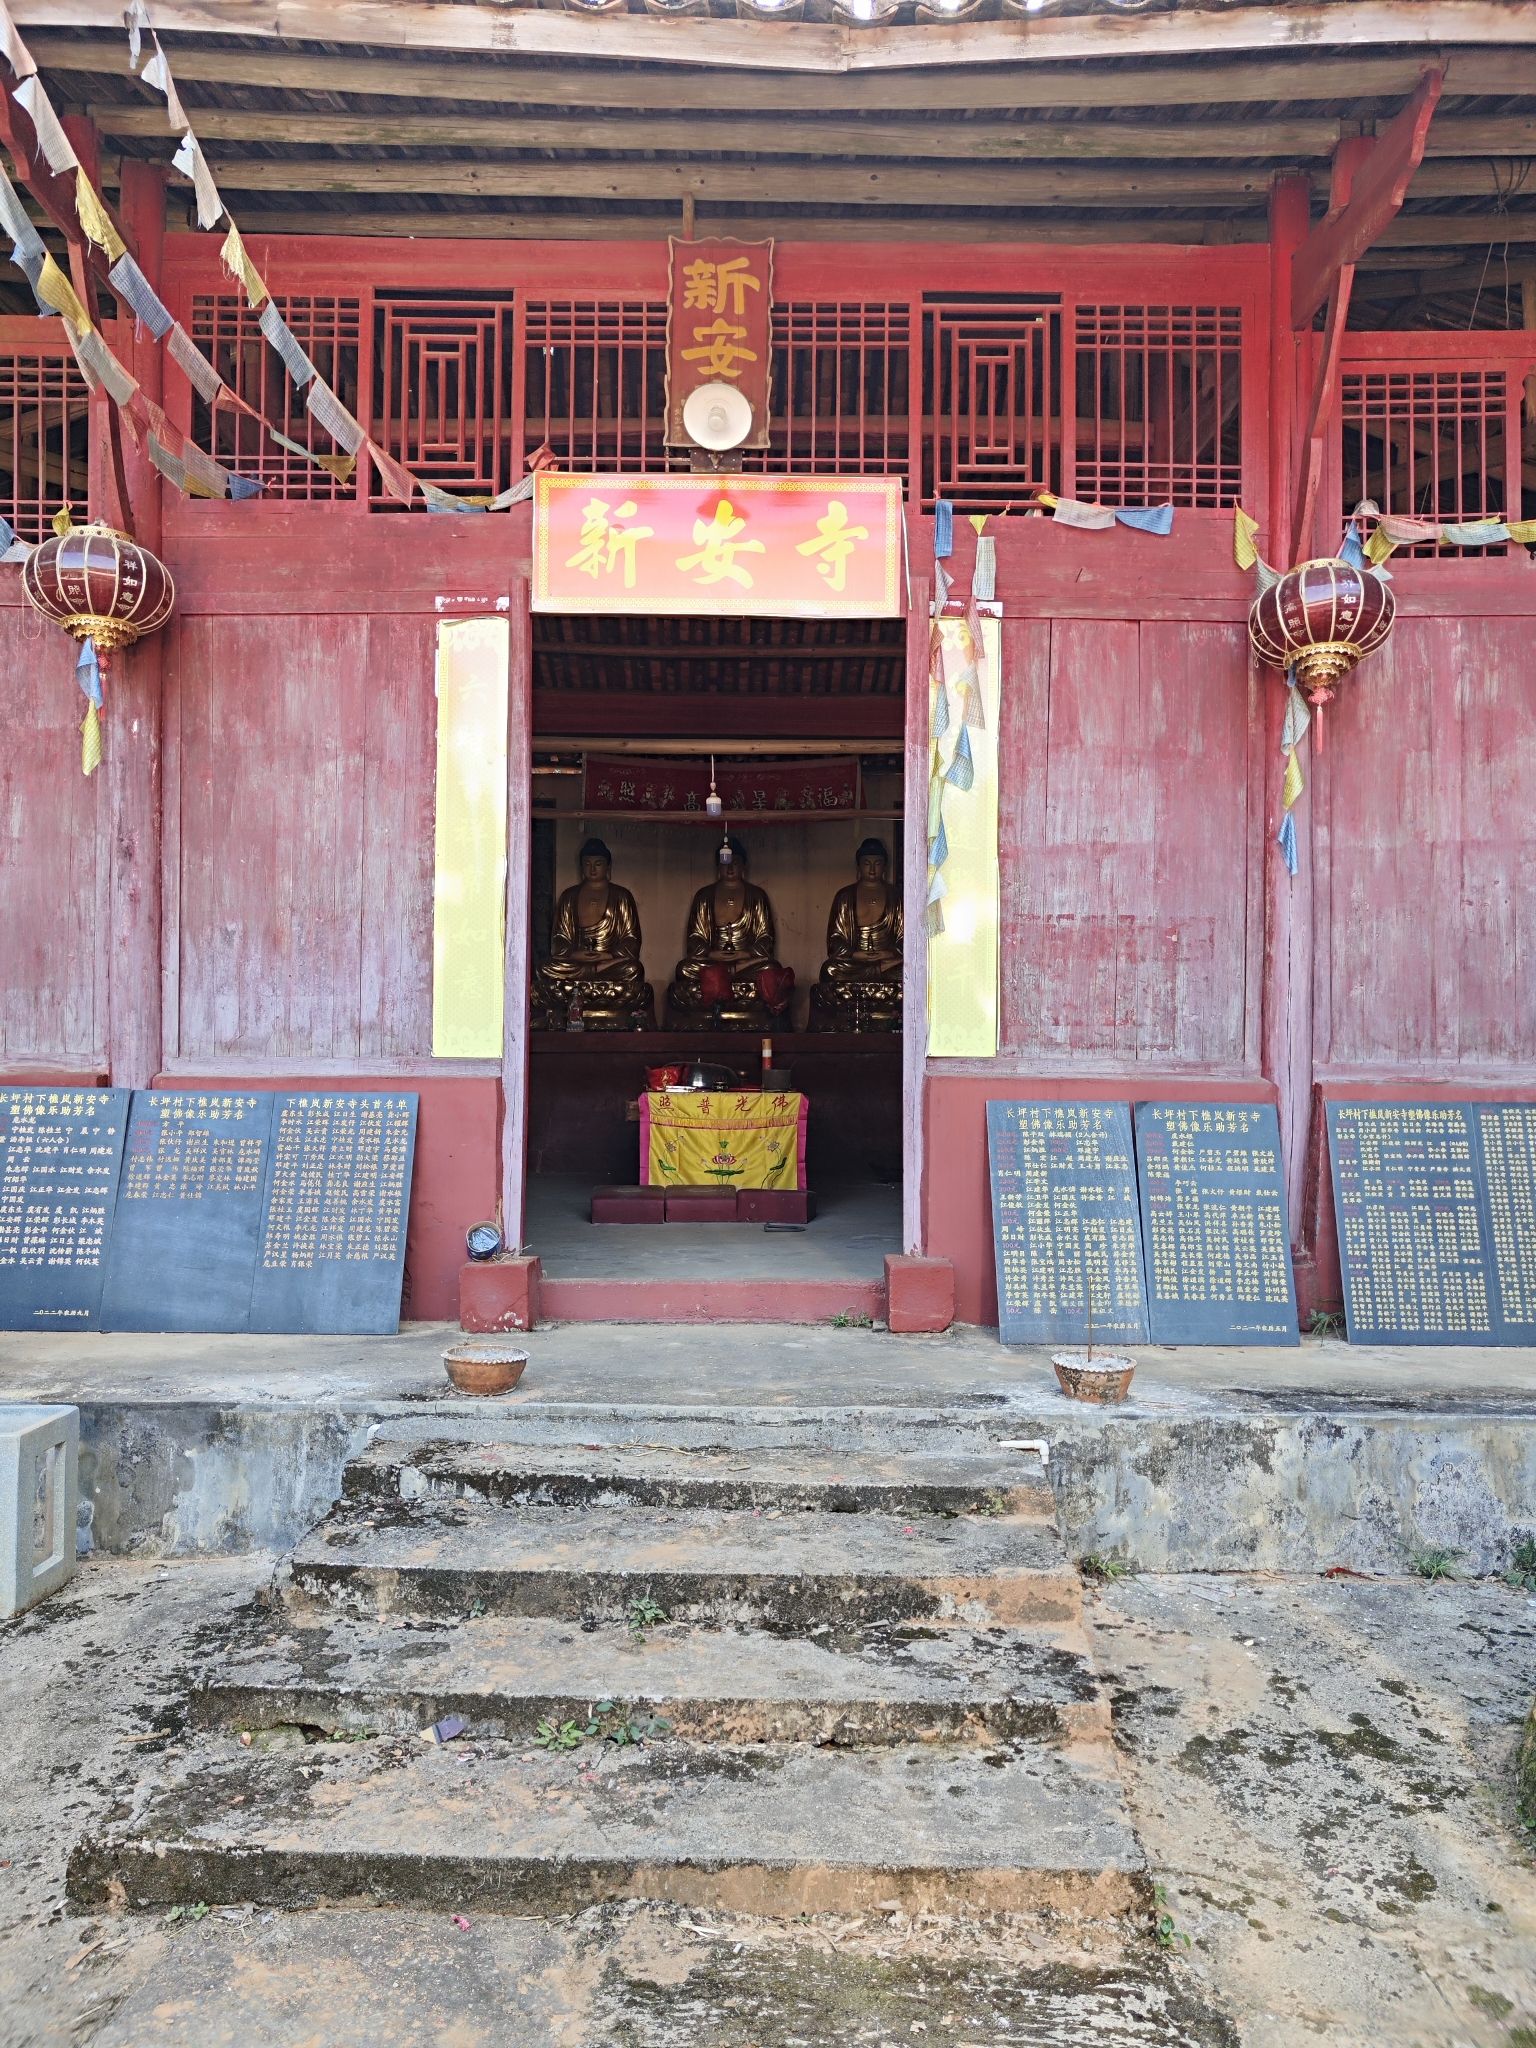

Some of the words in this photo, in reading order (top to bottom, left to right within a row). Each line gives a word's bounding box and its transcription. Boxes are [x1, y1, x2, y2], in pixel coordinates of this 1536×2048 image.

[680, 256, 760, 412] 新安
[565, 497, 869, 592] 新安寺
[657, 1094, 790, 1116] 佛光普照
[160, 1108, 245, 1120] 塑佛像乐助芳名
[1018, 1119, 1102, 1131] 塑佛像乐助芳名
[1165, 1121, 1250, 1134] 塑佛像乐助芳名
